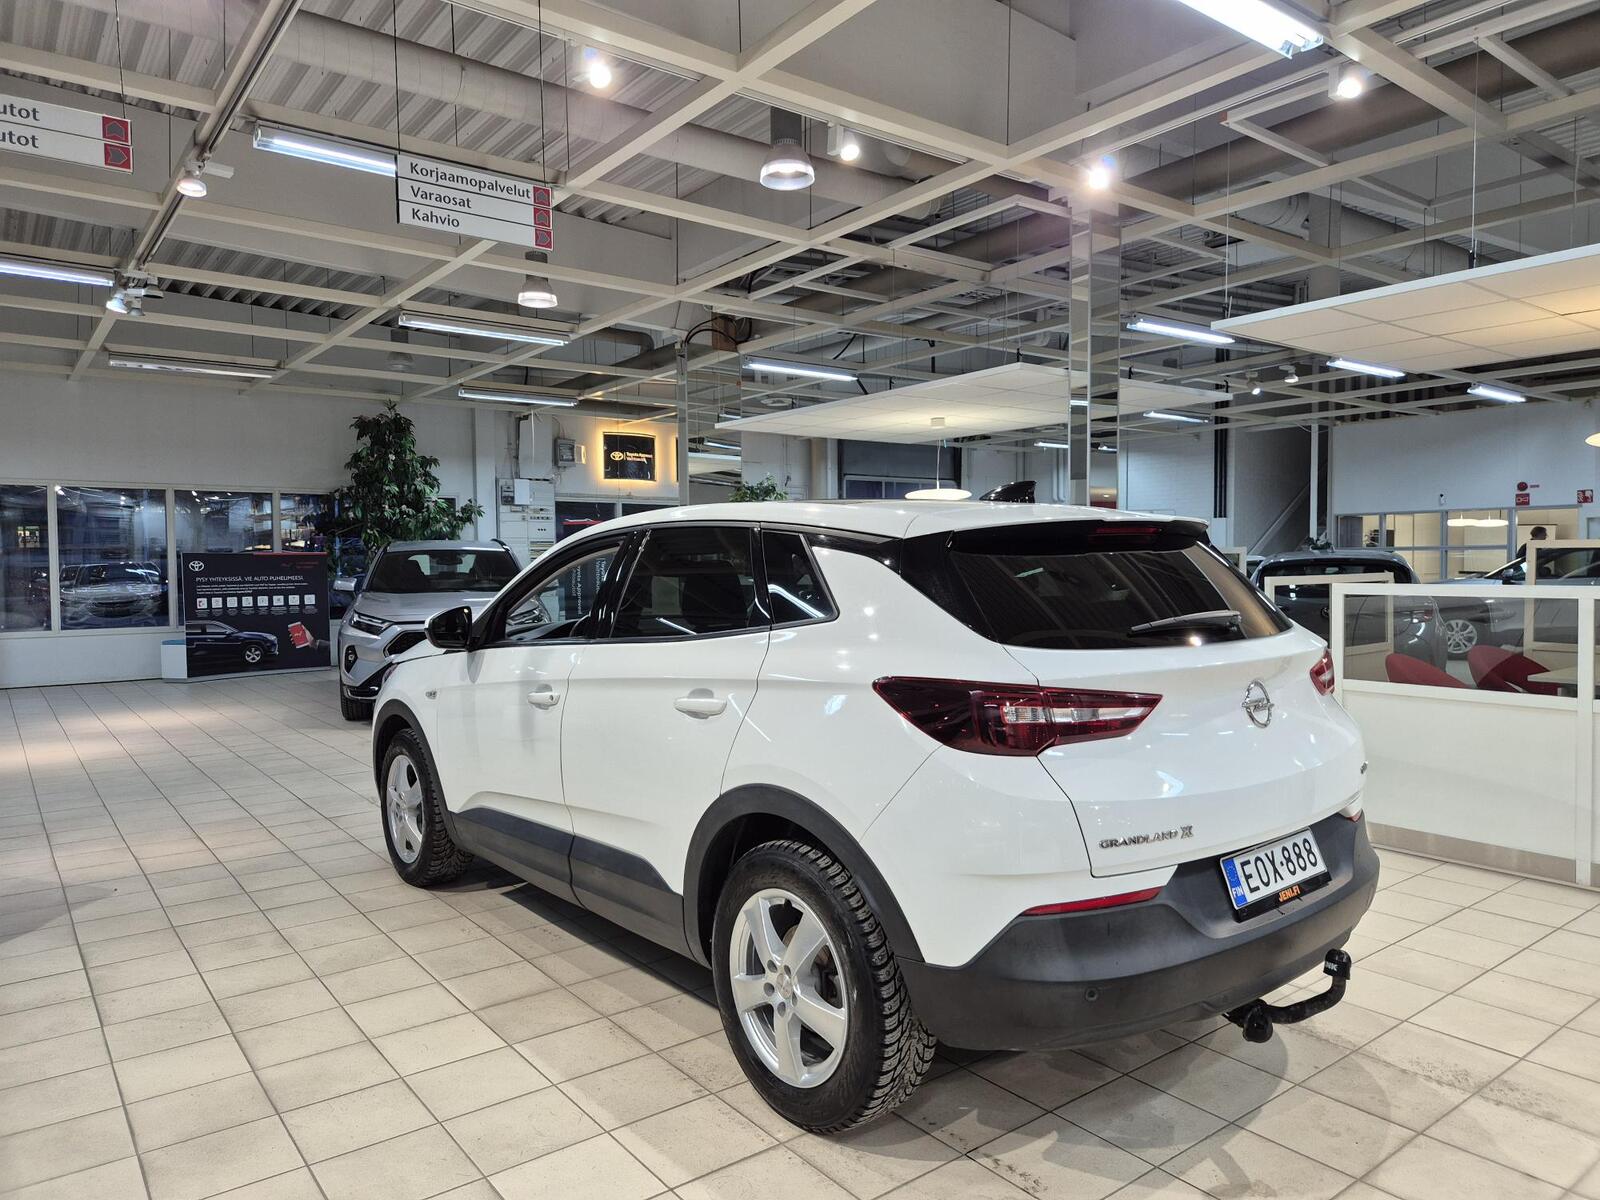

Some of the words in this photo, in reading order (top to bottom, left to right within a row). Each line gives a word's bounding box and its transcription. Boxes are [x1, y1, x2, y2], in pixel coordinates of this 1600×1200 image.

[410, 162, 531, 199] Korjaamopalvelut
[411, 185, 472, 209] Varaosat
[412, 208, 460, 228] Kahvio
[1099, 829, 1179, 848] GRANDLAND
[1180, 825, 1193, 839] X
[1232, 886, 1244, 898] FIN
[1240, 838, 1318, 893] EOX-888
